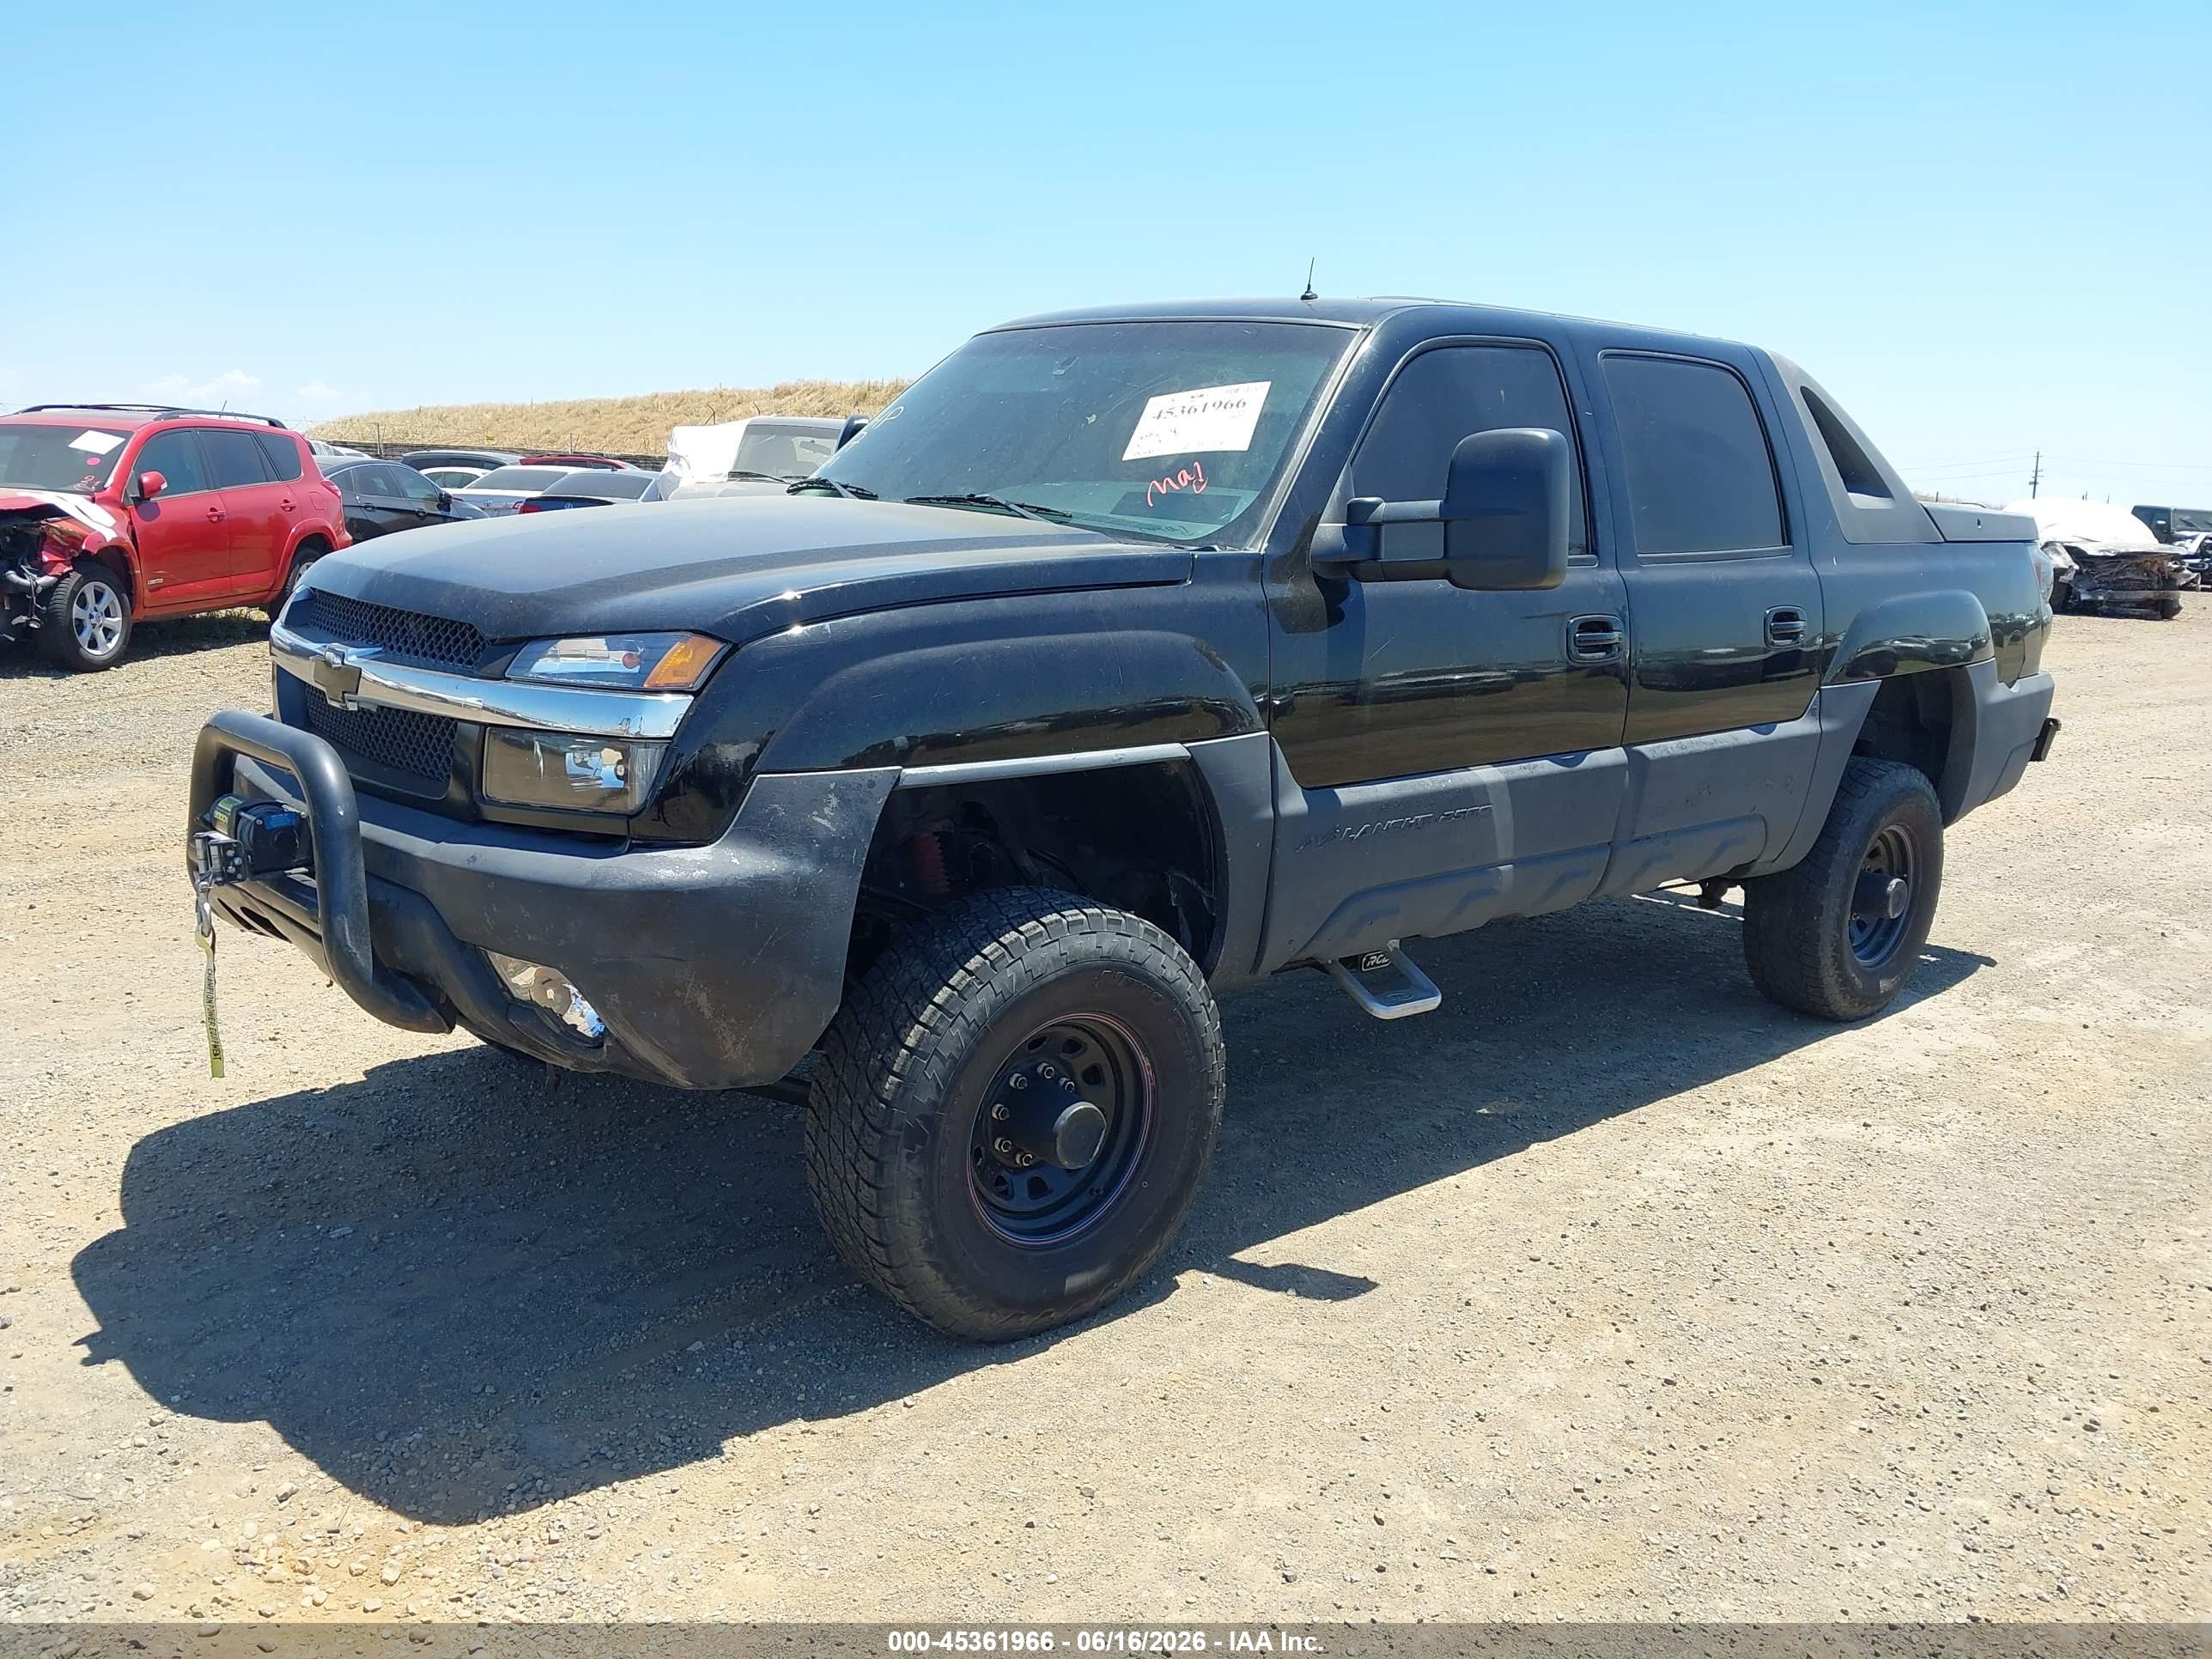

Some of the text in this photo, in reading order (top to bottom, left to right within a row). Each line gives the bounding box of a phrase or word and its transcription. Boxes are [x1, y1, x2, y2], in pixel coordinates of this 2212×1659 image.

[1152, 398, 1247, 420] 45361966
[205, 968, 215, 1004] CHAMPION
[207, 1003, 216, 1027] POWER
